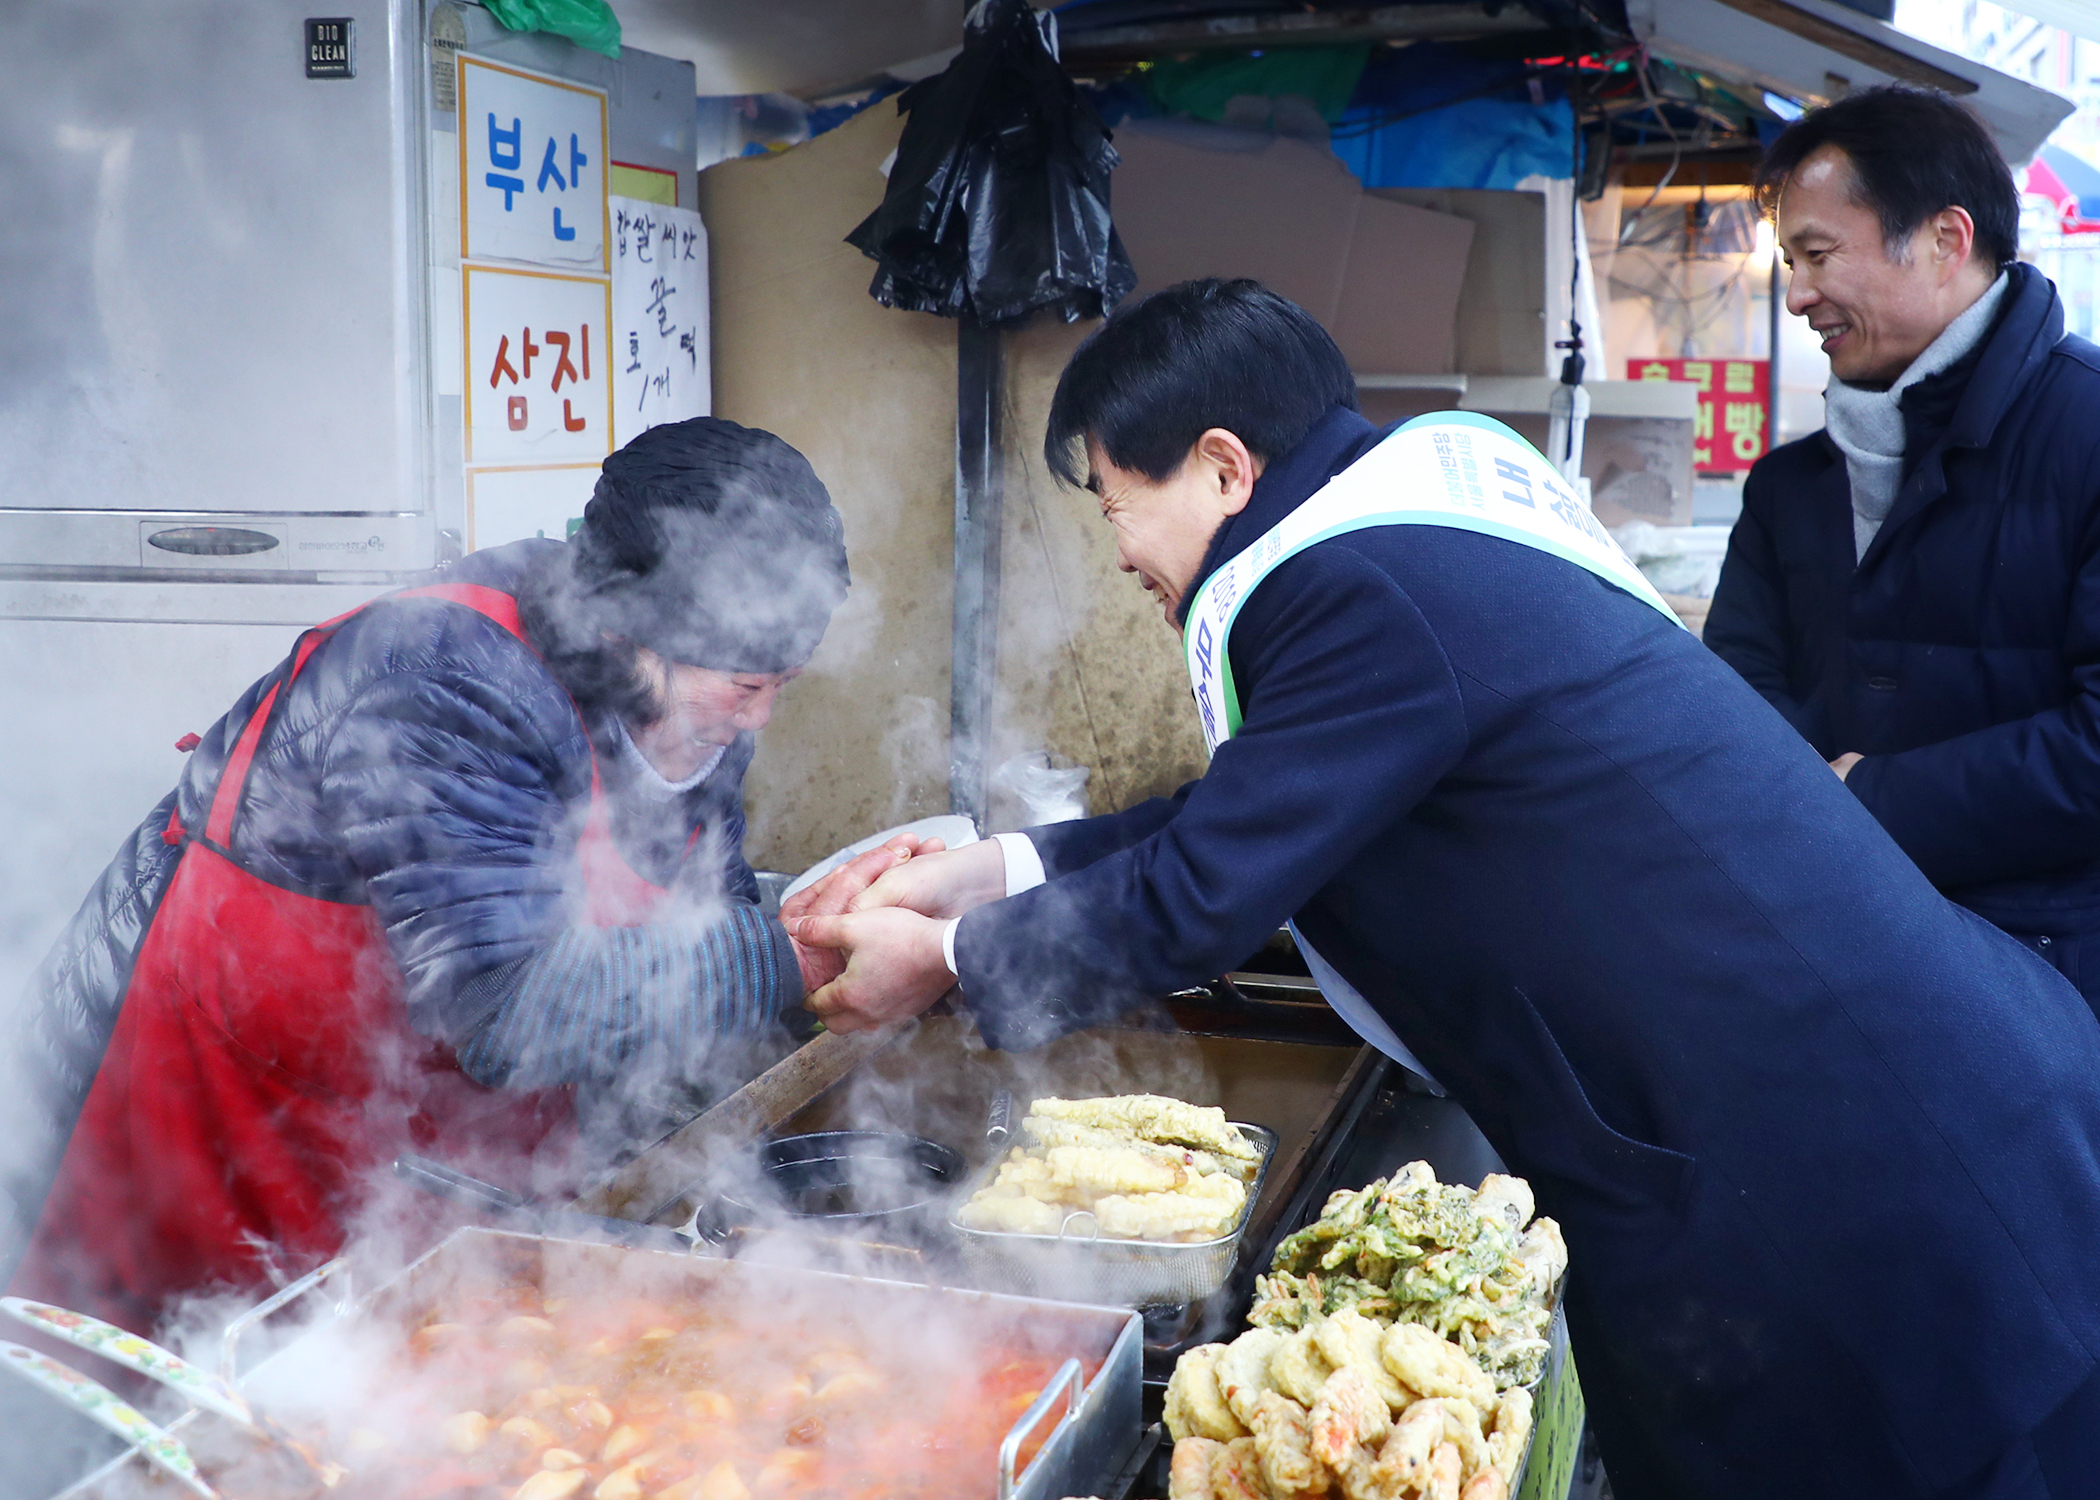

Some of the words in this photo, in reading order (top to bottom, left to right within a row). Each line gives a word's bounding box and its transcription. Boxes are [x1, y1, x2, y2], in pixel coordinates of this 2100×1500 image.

[311, 45, 345, 61] CLEAN
[318, 25, 338, 41] BIO
[486, 112, 587, 241] 부산
[490, 323, 590, 432] 삼진
[1494, 457, 1536, 510] 내
[1212, 565, 1237, 623] 2018
